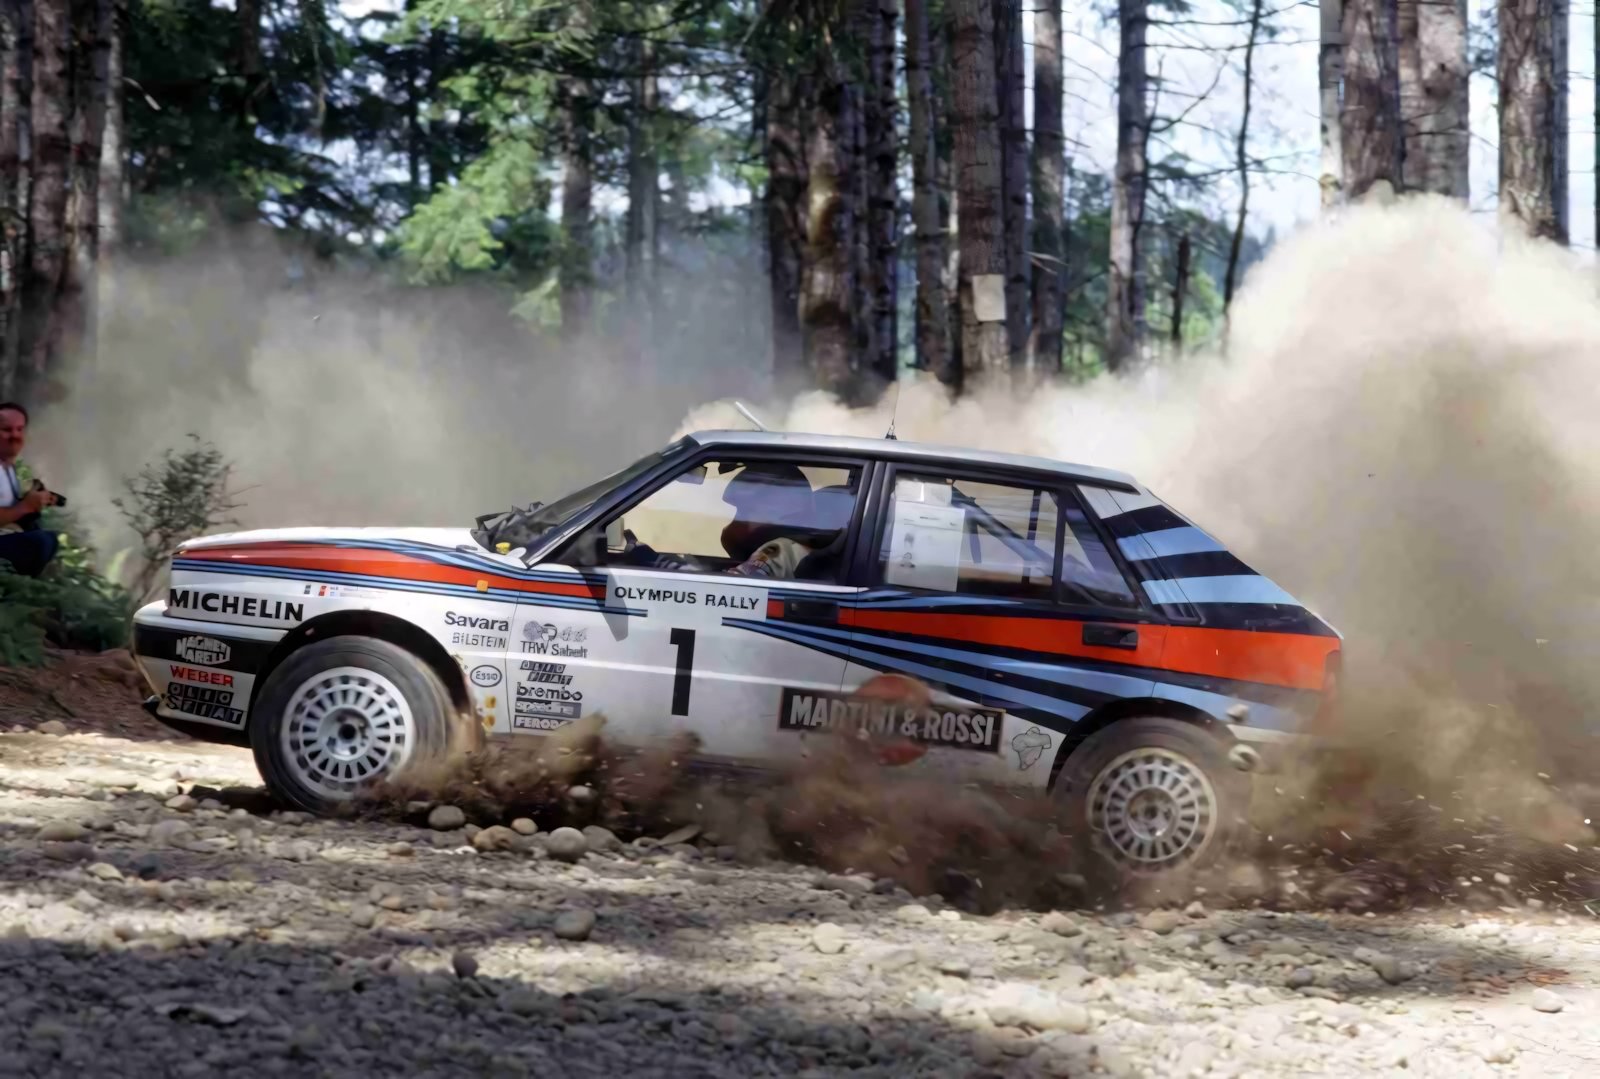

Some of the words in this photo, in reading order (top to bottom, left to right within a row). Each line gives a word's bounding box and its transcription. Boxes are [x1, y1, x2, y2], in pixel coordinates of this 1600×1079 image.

[169, 588, 303, 622] MICHELIN
[614, 586, 697, 604] OLYMPUS
[705, 594, 760, 610] RALLY
[444, 611, 509, 632] Savara
[452, 632, 507, 649] BILSTEIN
[520, 640, 550, 655] TRW
[170, 665, 234, 688] WEBER
[670, 628, 696, 716] 1
[169, 683, 233, 705] OLIO
[517, 681, 583, 701] brembo
[901, 711, 917, 736] &
[923, 713, 995, 746] ROSSI
